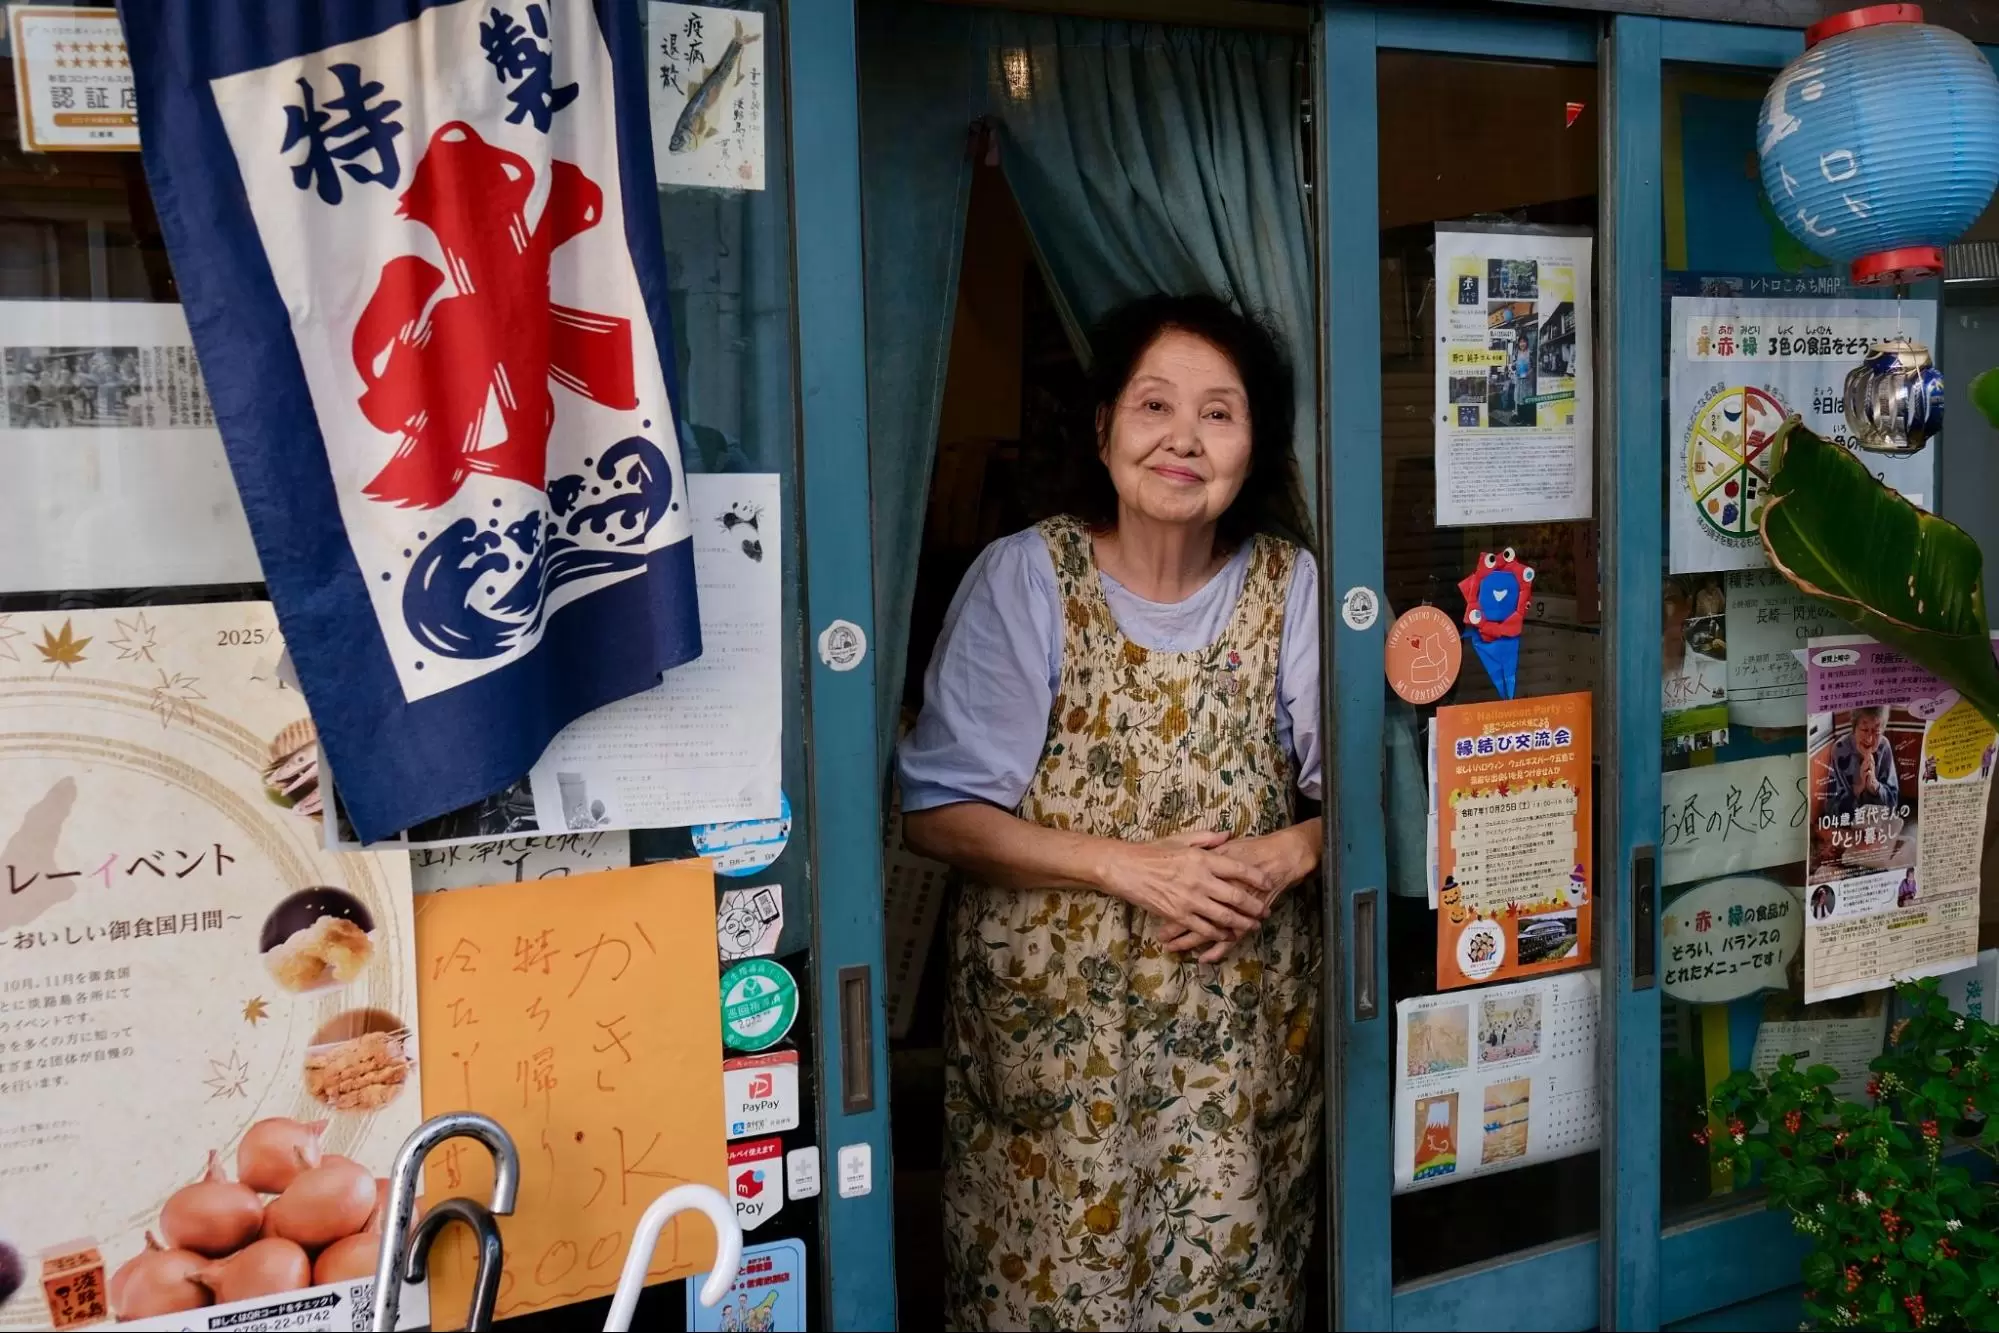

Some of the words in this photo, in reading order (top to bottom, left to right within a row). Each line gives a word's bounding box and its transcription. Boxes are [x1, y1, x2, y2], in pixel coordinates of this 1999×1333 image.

[660, 33, 685, 96] 退散
[51, 86, 137, 109] 認証店
[1750, 278, 1841, 294] レトロこみちMAP
[1813, 398, 1845, 415] 今日は
[1534, 703, 1562, 717] Party
[1455, 729, 1572, 757] 縁結び交流会
[1661, 775, 1779, 848] お昼の定食
[1831, 823, 1899, 848] ひとり暮らし
[6, 843, 236, 895] レーイベント
[742, 1099, 780, 1112] PayPay
[736, 1202, 764, 1216] Pay
